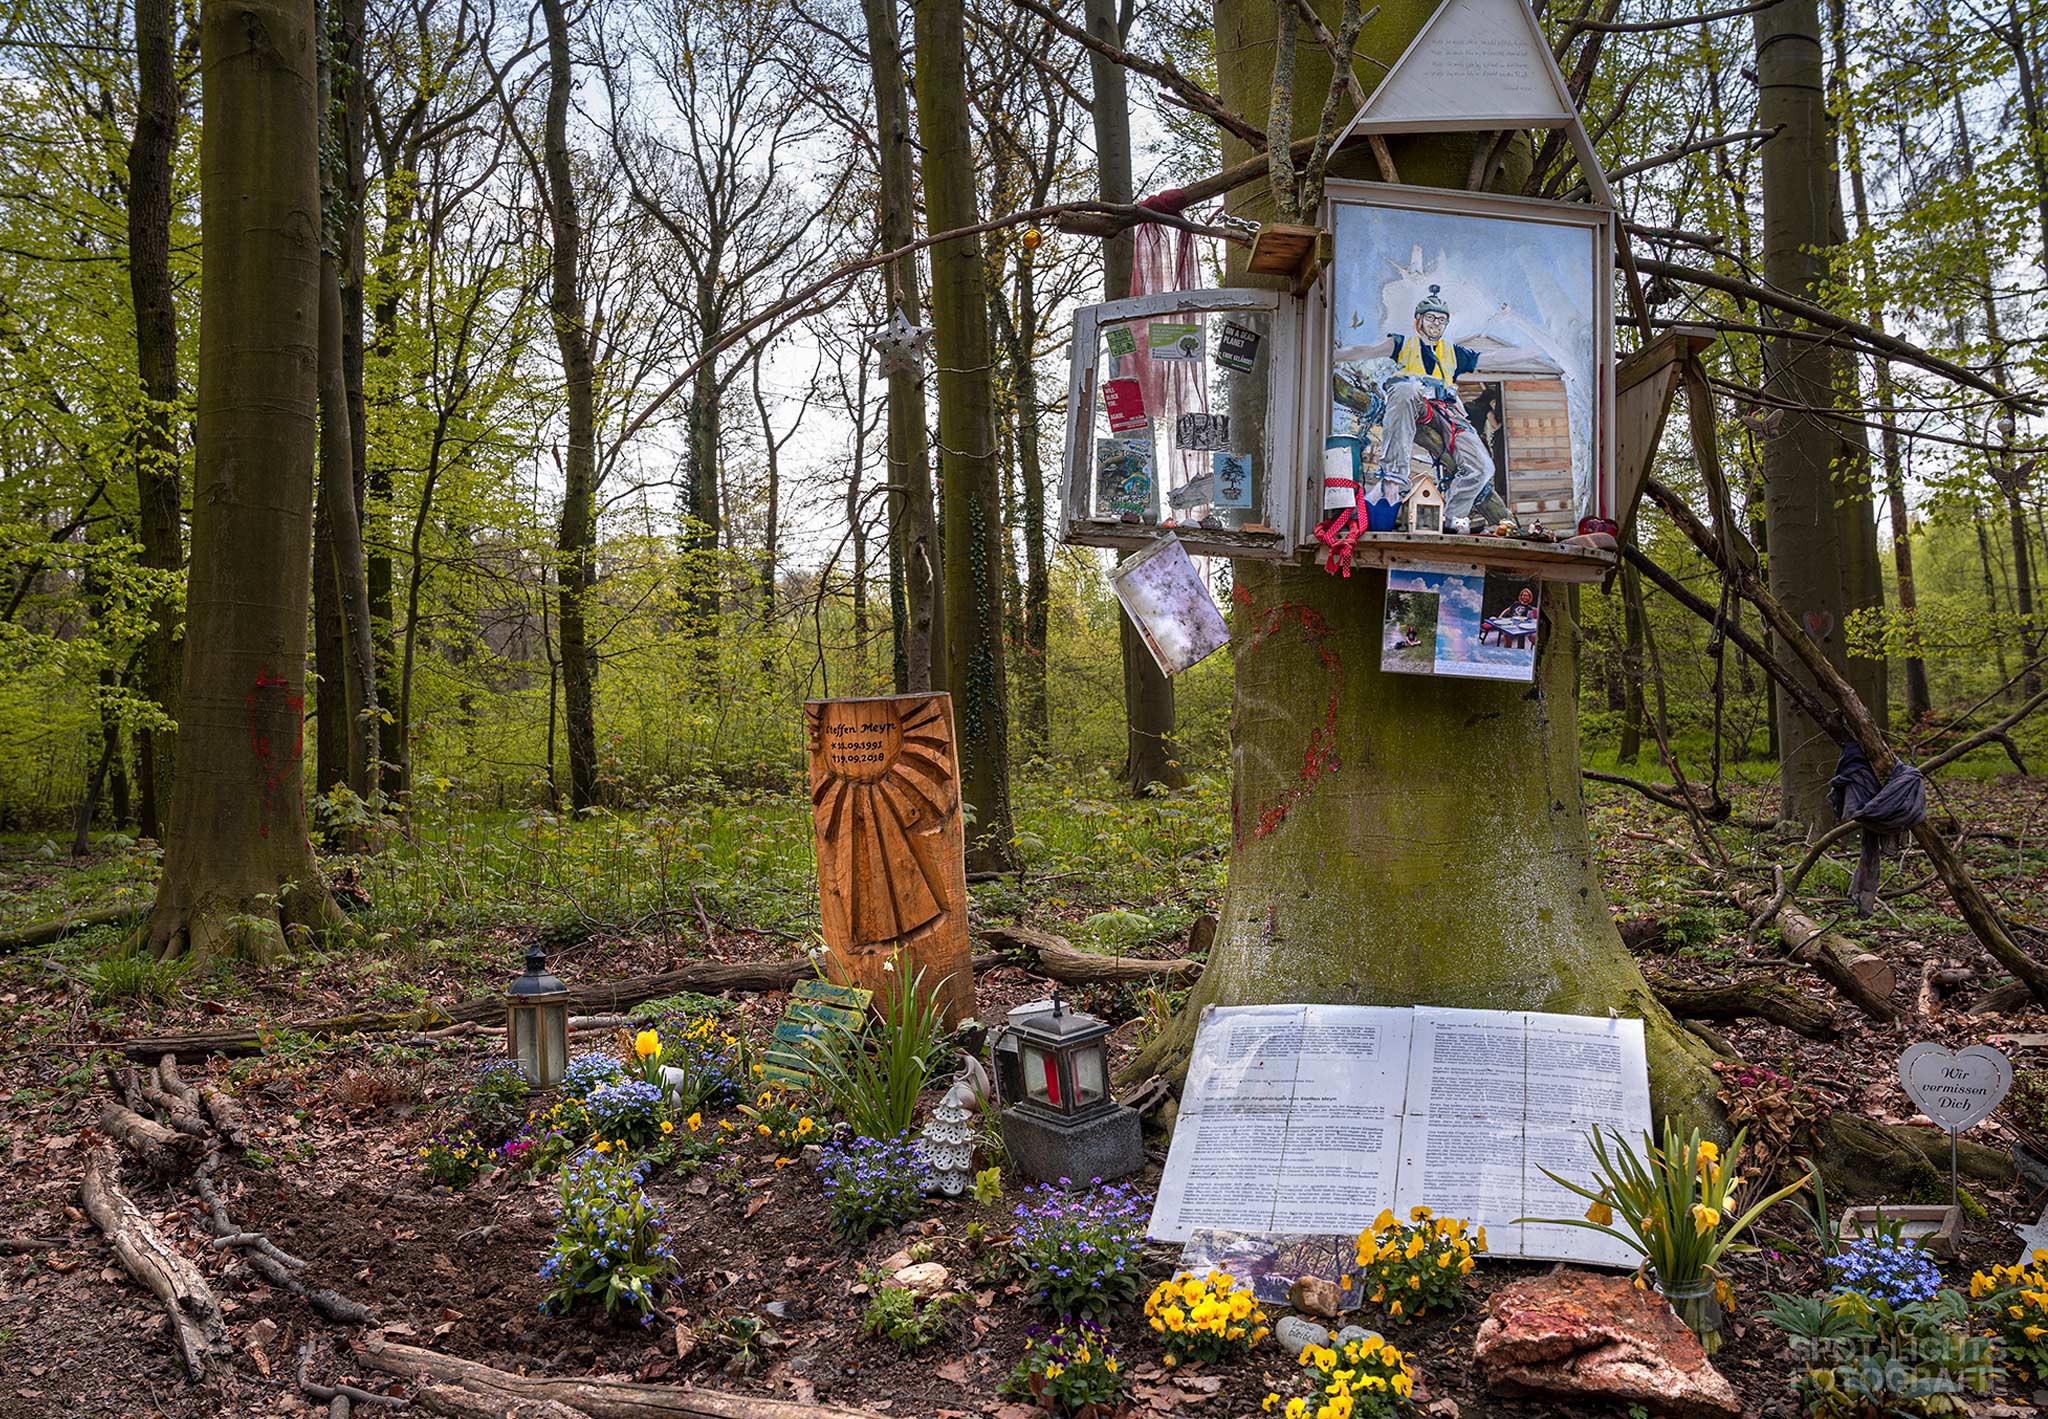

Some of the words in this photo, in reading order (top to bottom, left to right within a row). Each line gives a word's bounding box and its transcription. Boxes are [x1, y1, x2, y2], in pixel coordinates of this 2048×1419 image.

[1222, 335, 1245, 348] PLANET
[1941, 1067, 1970, 1080] Wir
[1922, 1083, 1987, 1096] vermissen
[1938, 1096, 1971, 1112] Dich
